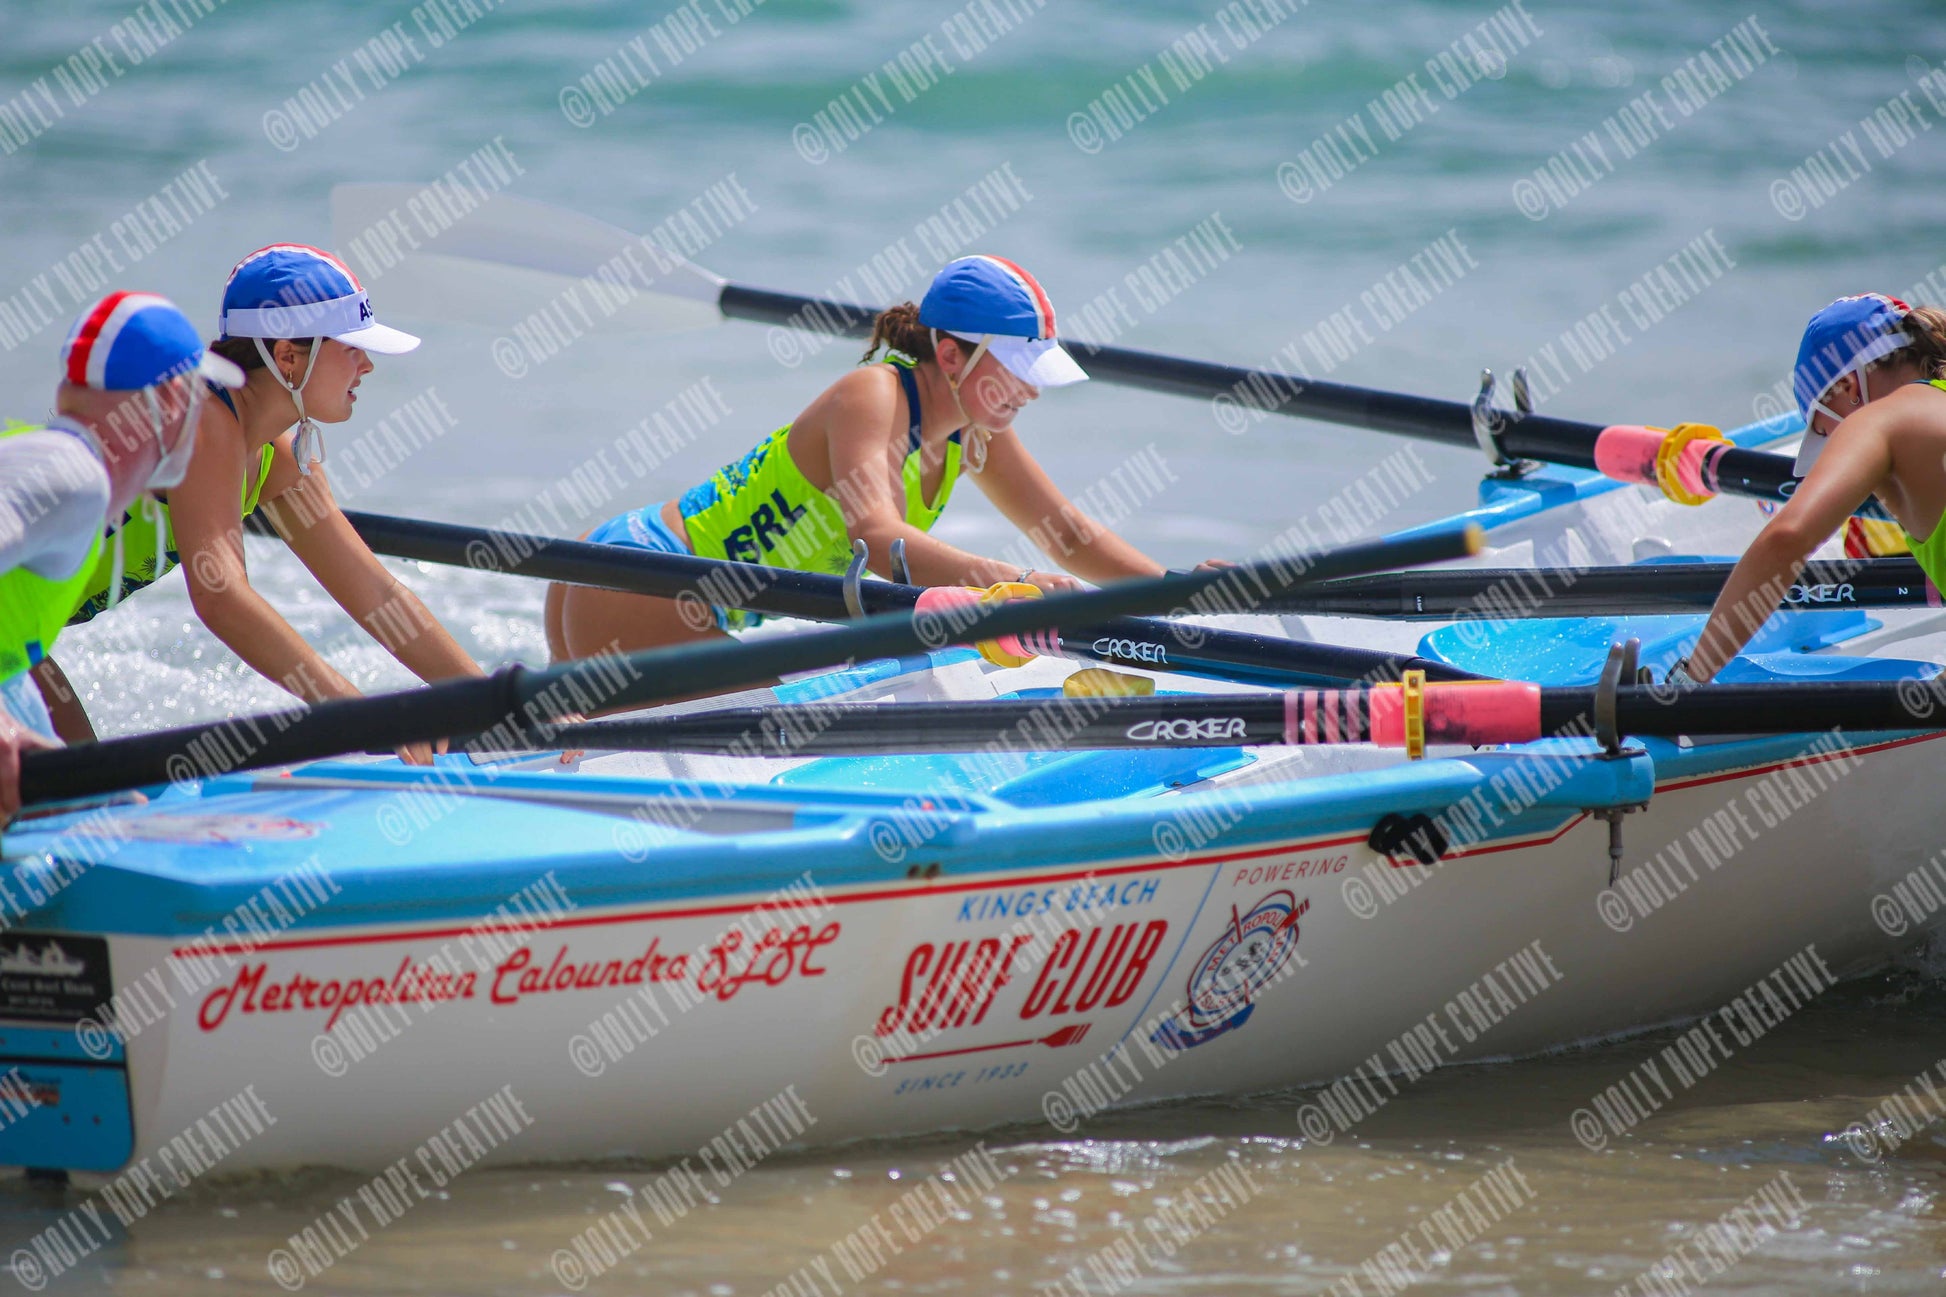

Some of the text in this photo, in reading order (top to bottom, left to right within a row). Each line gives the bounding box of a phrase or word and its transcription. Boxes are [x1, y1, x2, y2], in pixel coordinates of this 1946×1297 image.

[1898, 587, 1909, 596] 2
[1092, 637, 1168, 665] CROKER
[1126, 717, 1247, 741] CROKER
[1232, 856, 1349, 888] POWERING
[956, 879, 1161, 922] KINGS BEACH
[198, 956, 478, 1032] Metropolitan
[490, 936, 692, 1004] Caloundra
[874, 933, 1034, 1038] SURF
[1019, 919, 1169, 1020] CLUB
[893, 1070, 967, 1095] SINCE
